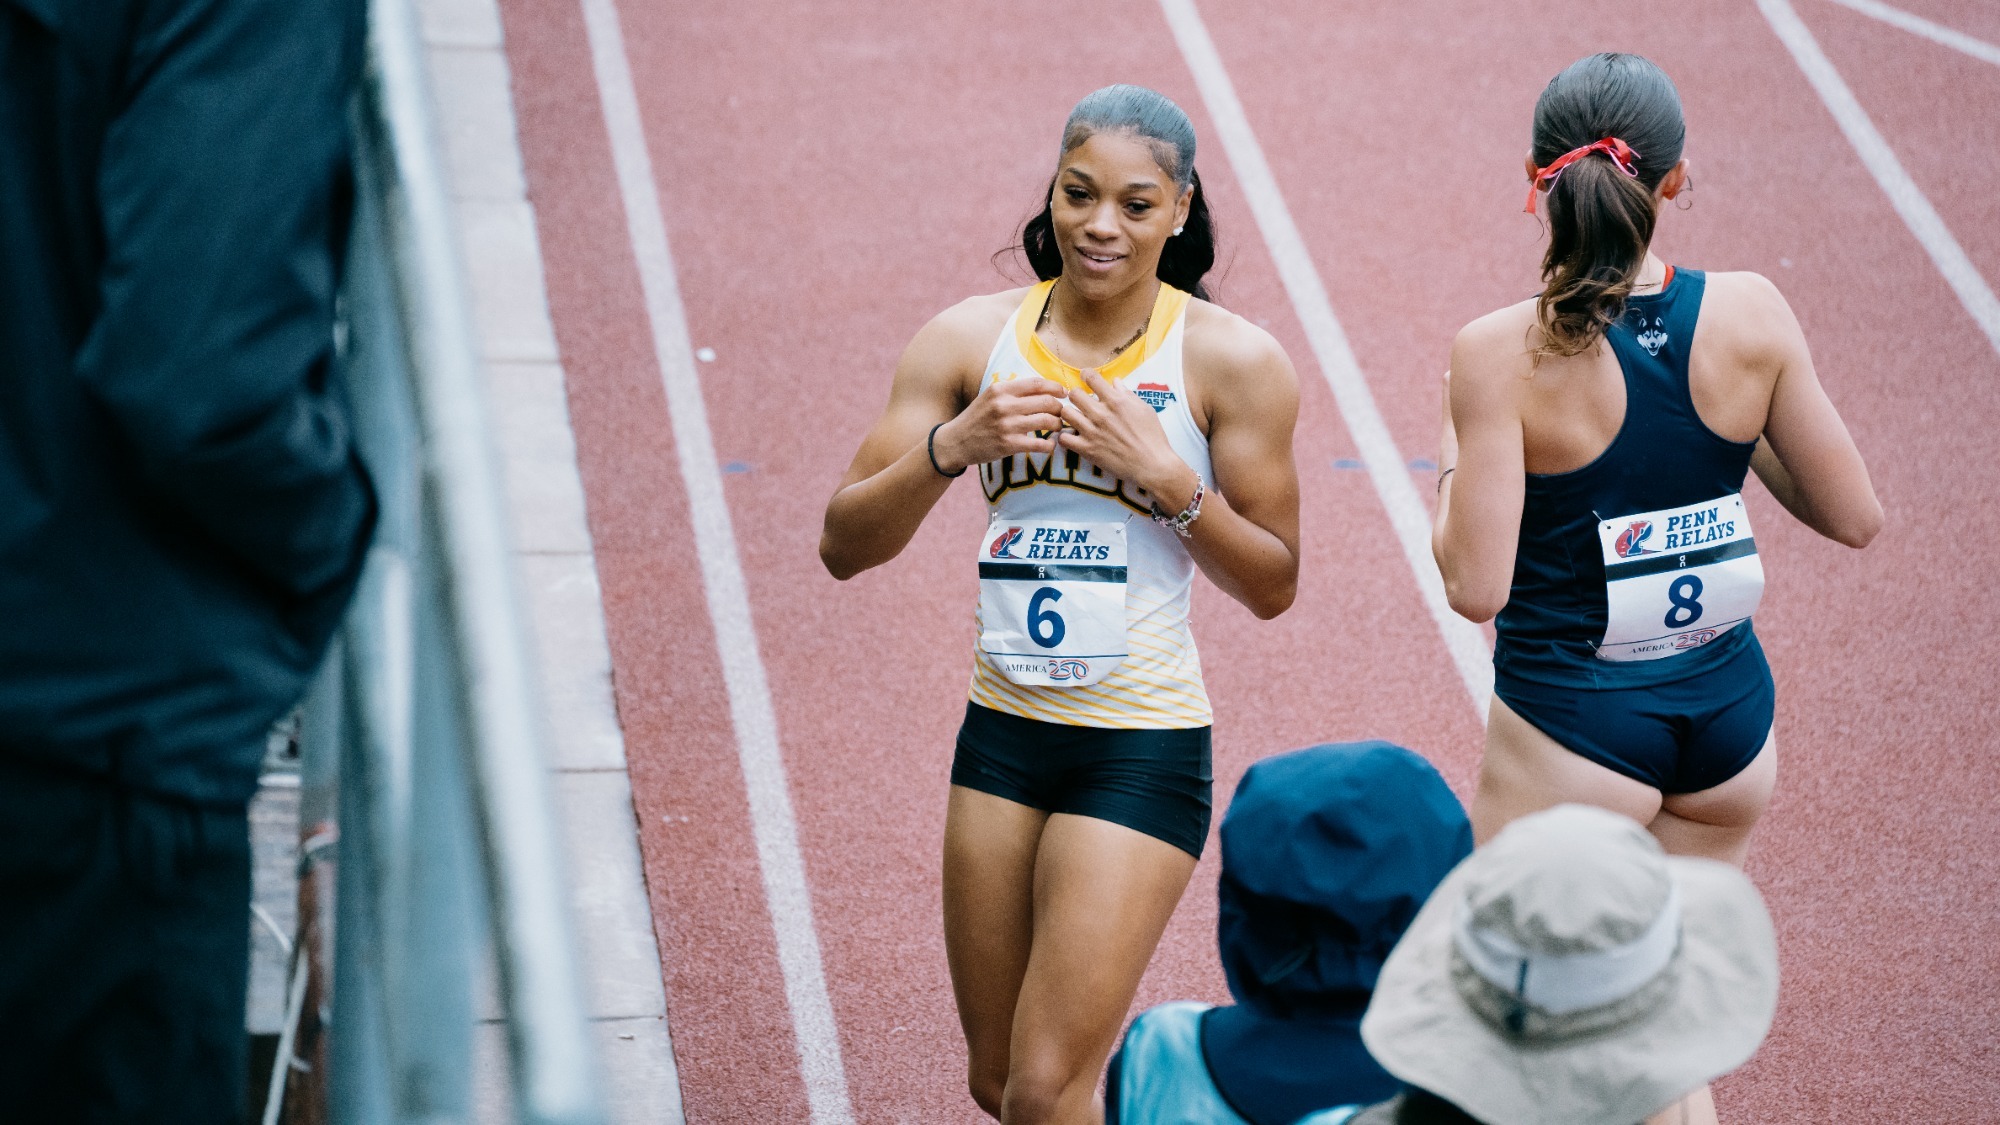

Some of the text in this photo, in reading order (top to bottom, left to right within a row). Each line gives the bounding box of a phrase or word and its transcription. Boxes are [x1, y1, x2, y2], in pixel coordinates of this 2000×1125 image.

[1133, 390, 1177, 402] MERICA
[1666, 507, 1719, 533] PENN
[1031, 527, 1090, 543] PENN
[1664, 520, 1735, 550] RELAYS
[1026, 543, 1110, 560] RELAYS
[1664, 574, 1704, 629] 8
[1027, 586, 1066, 649] 6
[1629, 629, 1717, 655] AMERICA 250
[1005, 659, 1090, 681] AMERICA 250
